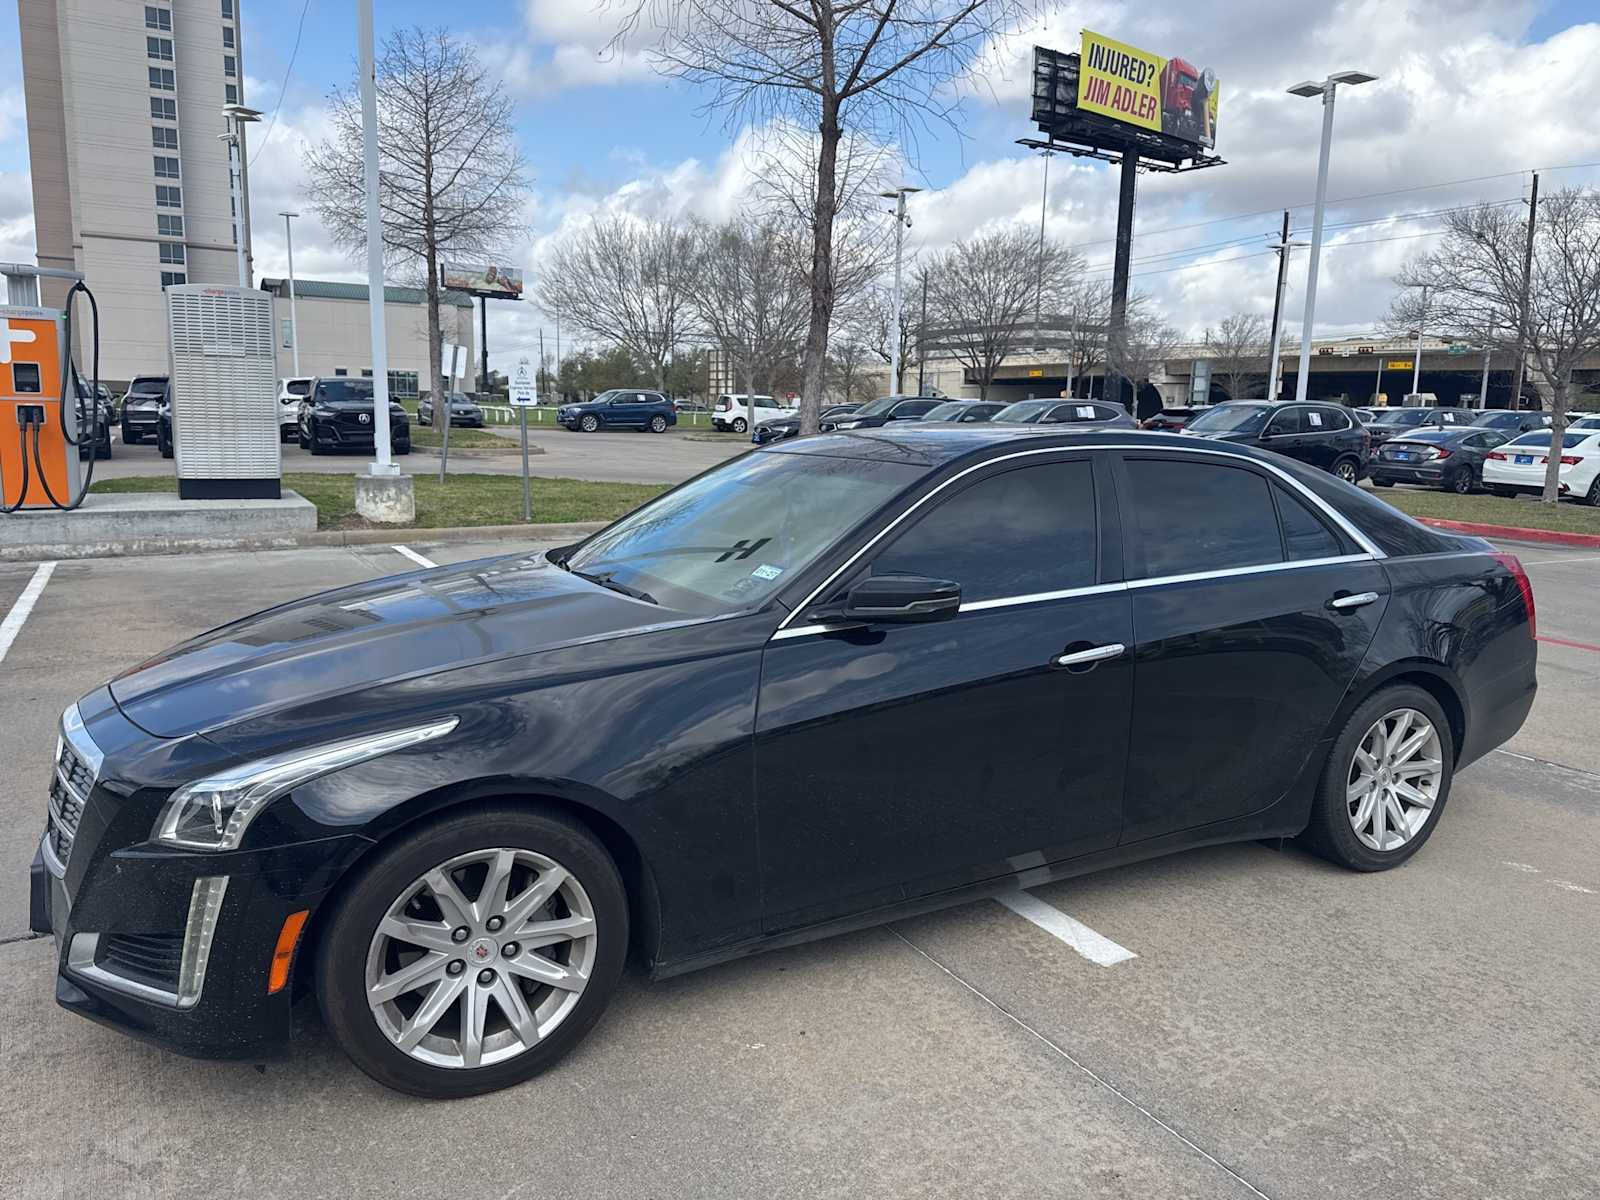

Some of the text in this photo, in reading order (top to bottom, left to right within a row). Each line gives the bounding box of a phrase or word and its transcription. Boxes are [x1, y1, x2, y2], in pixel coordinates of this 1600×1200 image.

[1088, 42, 1155, 87] INJURED?
[1083, 75, 1157, 121] JIM ADLER
